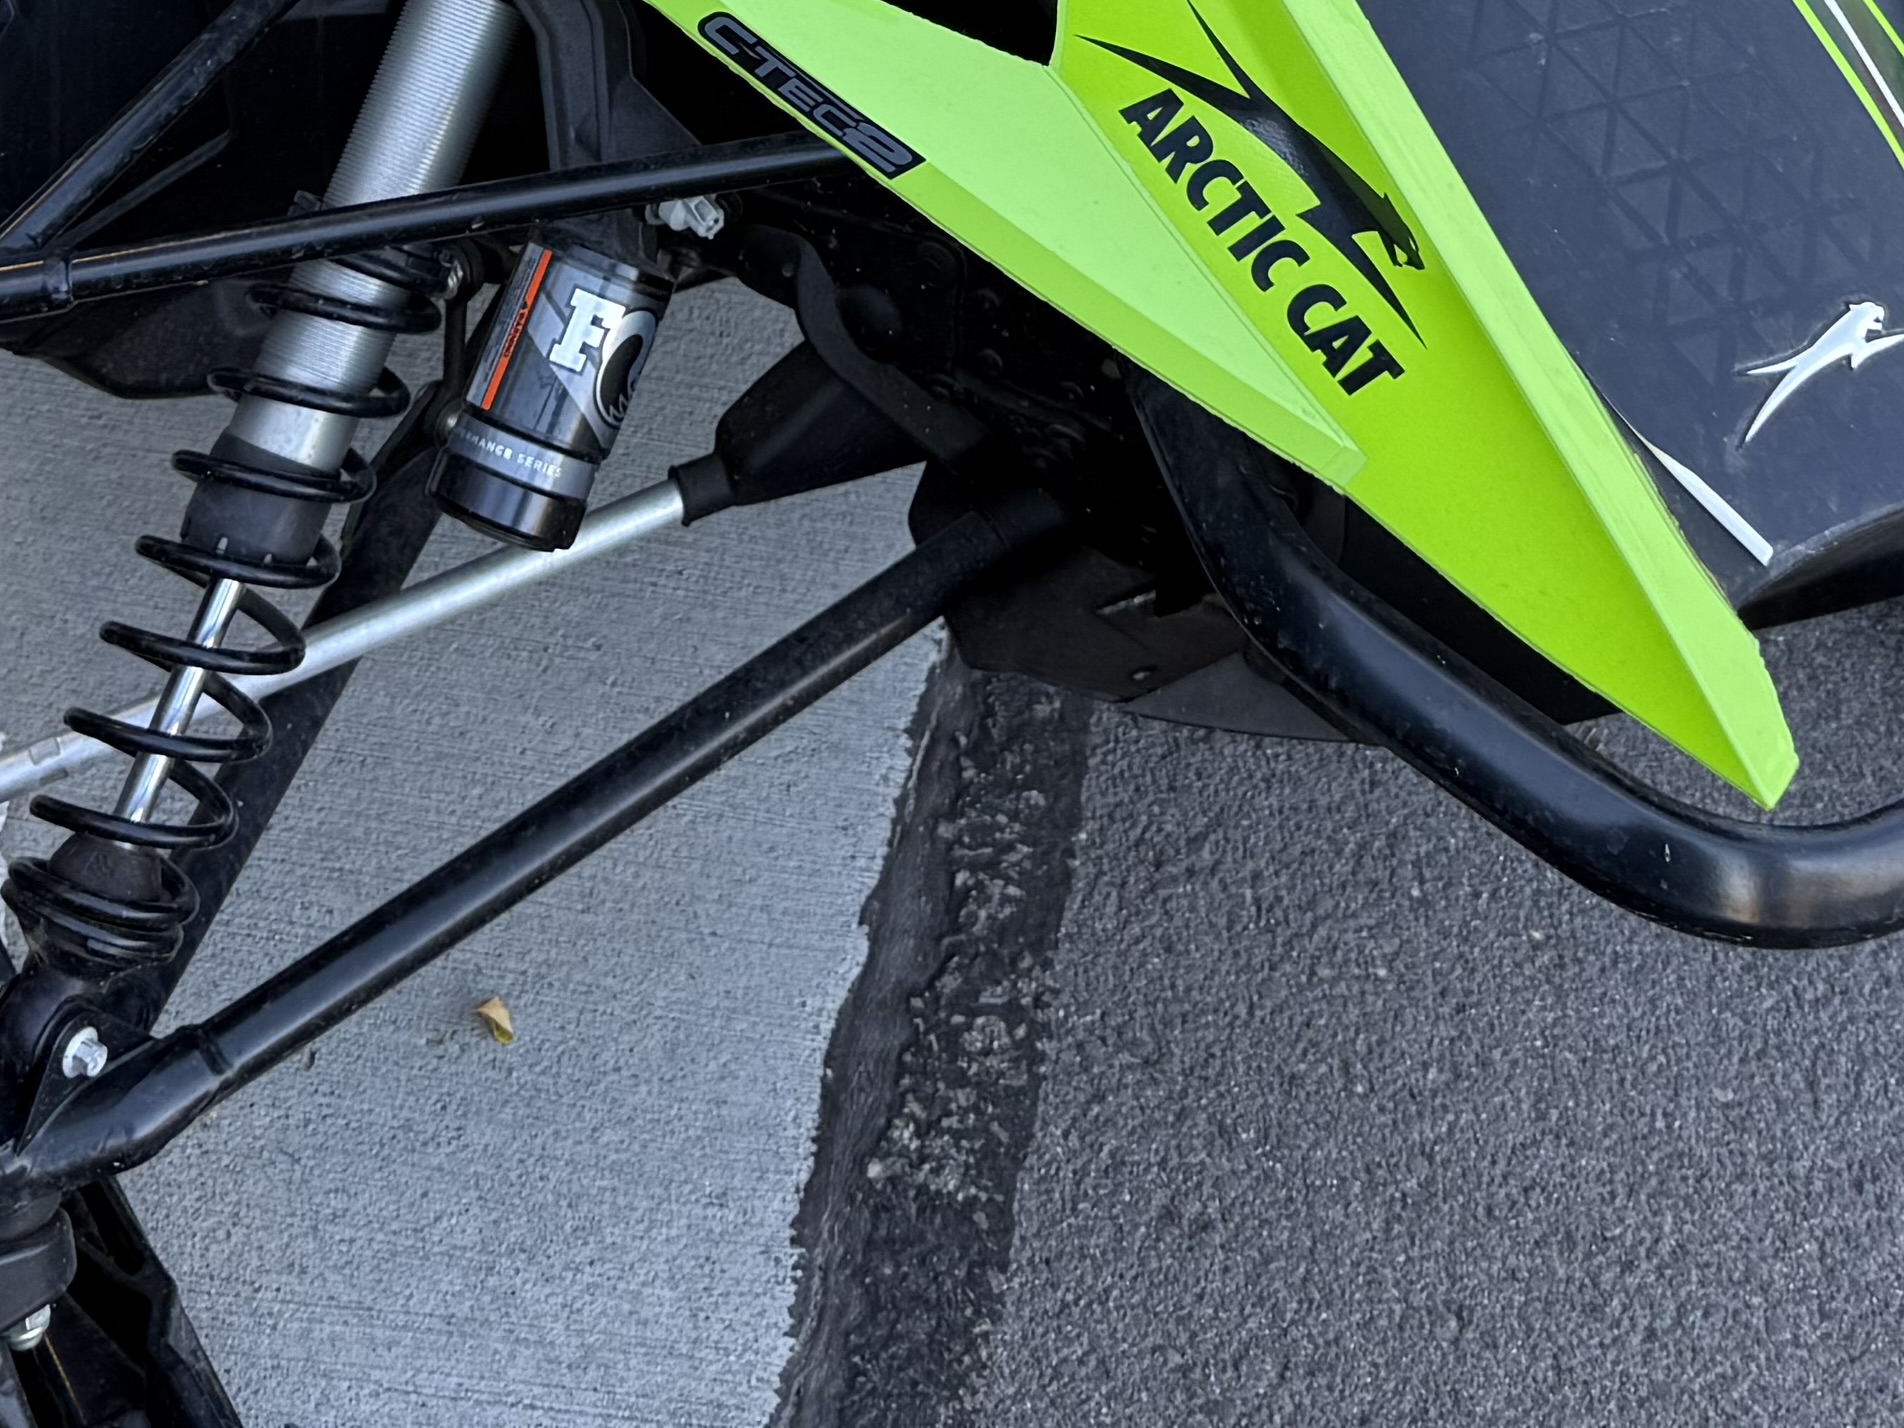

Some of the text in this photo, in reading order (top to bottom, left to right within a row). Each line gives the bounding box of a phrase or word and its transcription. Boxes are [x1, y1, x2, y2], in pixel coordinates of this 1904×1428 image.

[1117, 87, 1406, 397] ARCTIC CAT
[516, 452, 563, 479] SERIES
